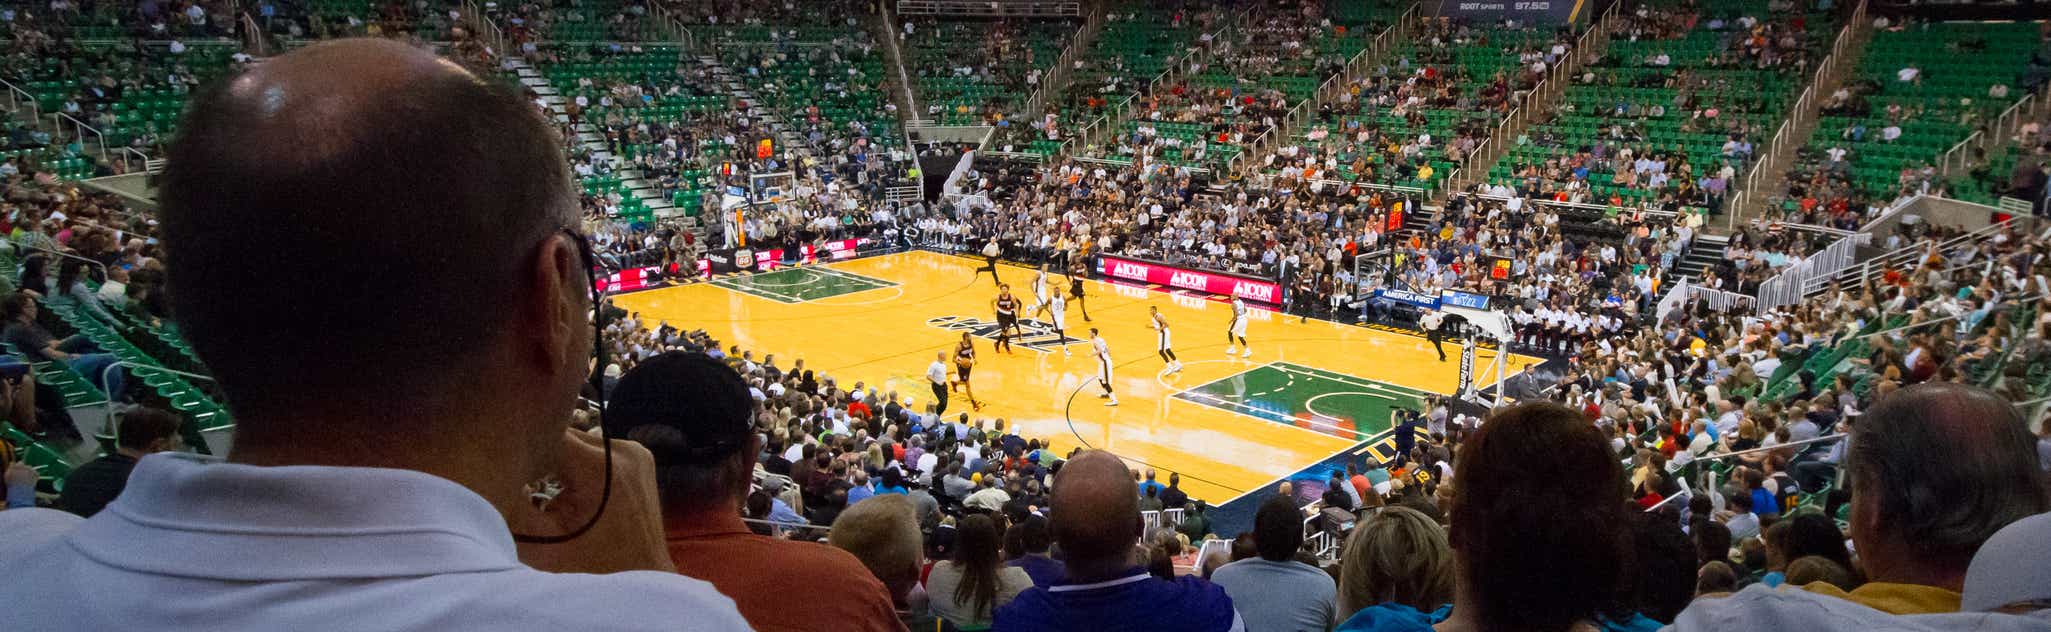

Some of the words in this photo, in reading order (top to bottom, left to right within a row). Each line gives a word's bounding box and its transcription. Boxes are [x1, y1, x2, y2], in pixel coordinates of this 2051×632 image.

[1123, 263, 1149, 278] ICON
[1180, 272, 1208, 288] ICON
[1244, 283, 1274, 299] ICON
[1382, 290, 1414, 301] AMERICA
[1414, 294, 1435, 305] FIRST
